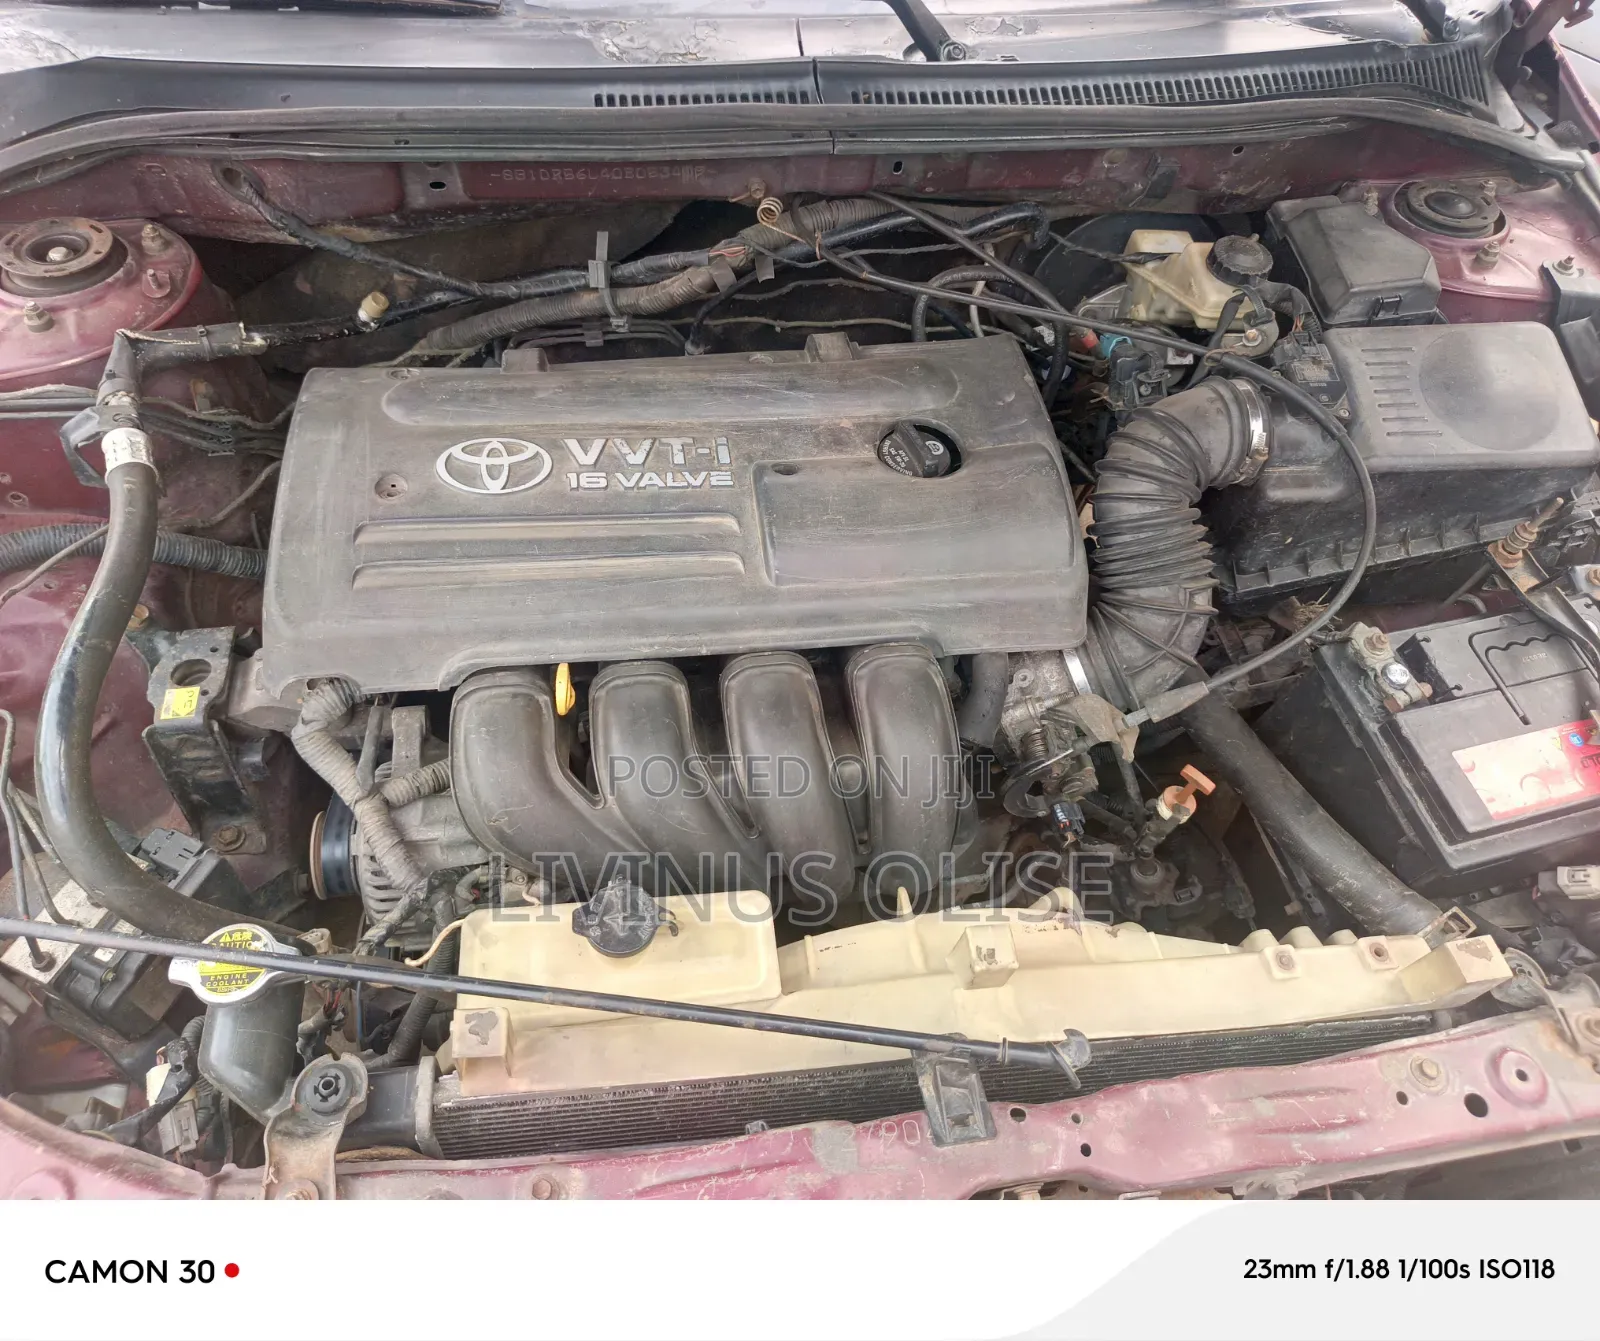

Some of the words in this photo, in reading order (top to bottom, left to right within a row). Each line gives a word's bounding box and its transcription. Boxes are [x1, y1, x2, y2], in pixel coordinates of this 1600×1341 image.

[561, 437, 732, 466] VVT-i
[884, 455, 913, 476] CONSERVING
[566, 472, 608, 489] 16
[614, 471, 734, 489] VALVE
[205, 979, 249, 987] COOLANT
[210, 973, 248, 981] ENGINE
